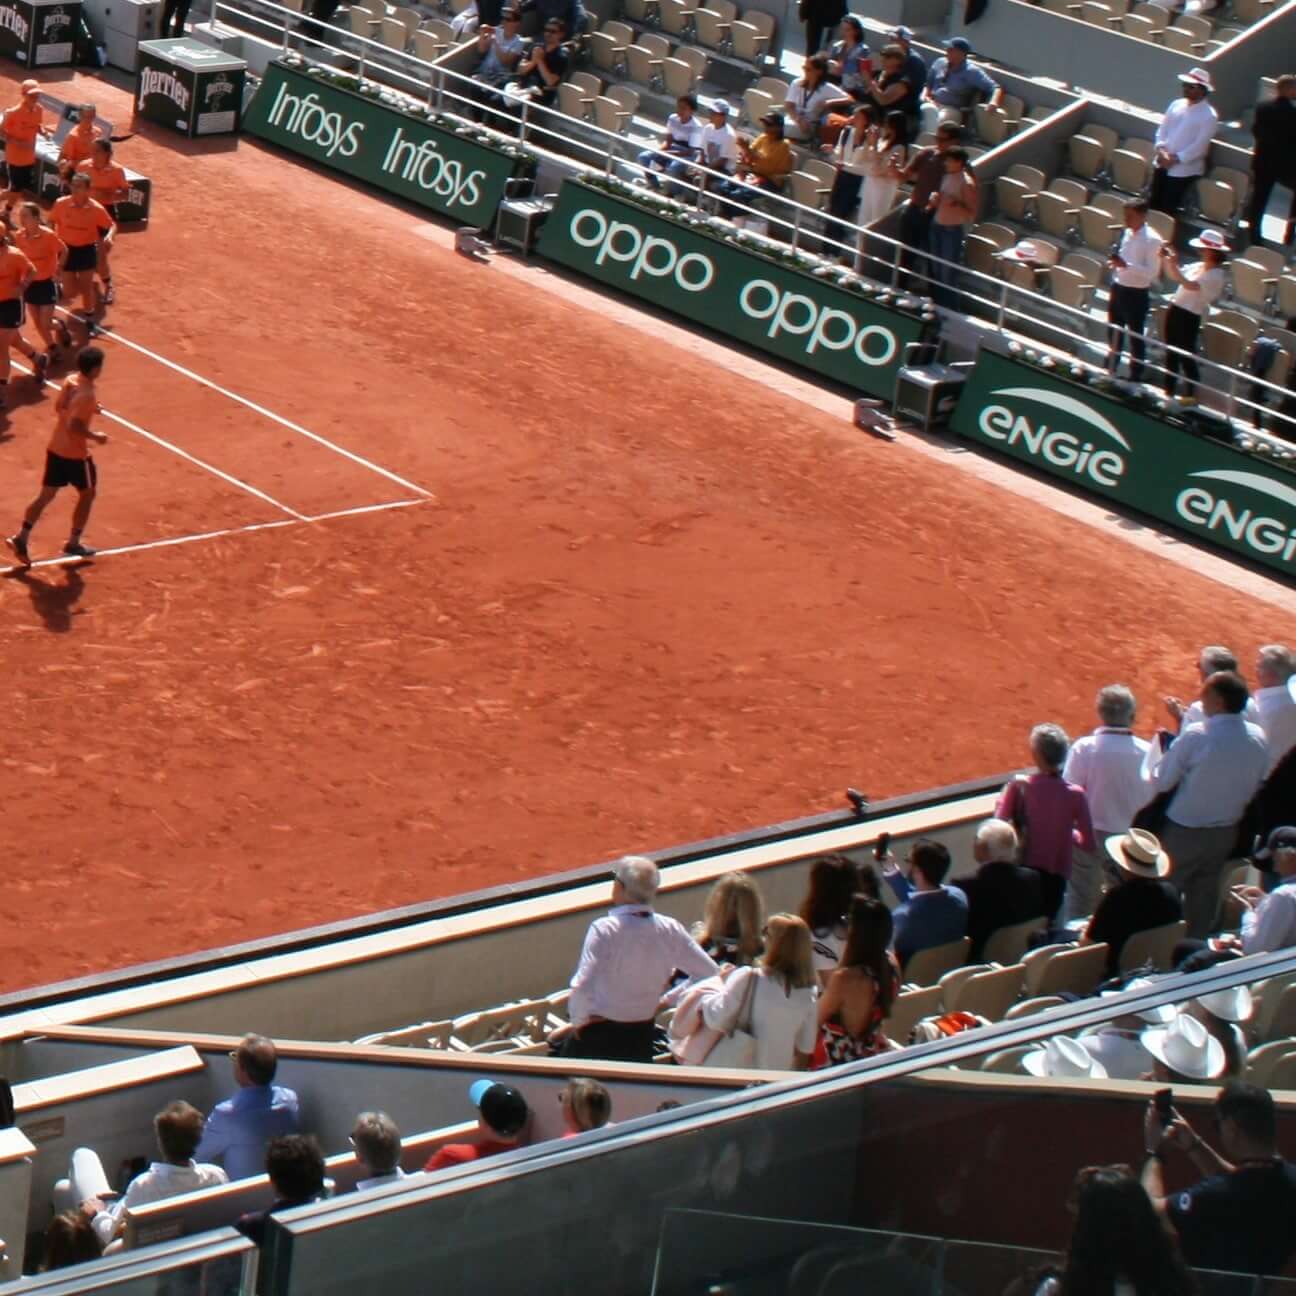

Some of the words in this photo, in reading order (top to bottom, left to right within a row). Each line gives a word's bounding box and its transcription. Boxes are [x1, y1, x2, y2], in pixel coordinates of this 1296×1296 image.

[138, 66, 190, 112] perrier
[267, 80, 365, 158] Infosys
[382, 126, 487, 207] Infosys
[569, 207, 715, 293] oppo
[739, 279, 897, 367] oppo
